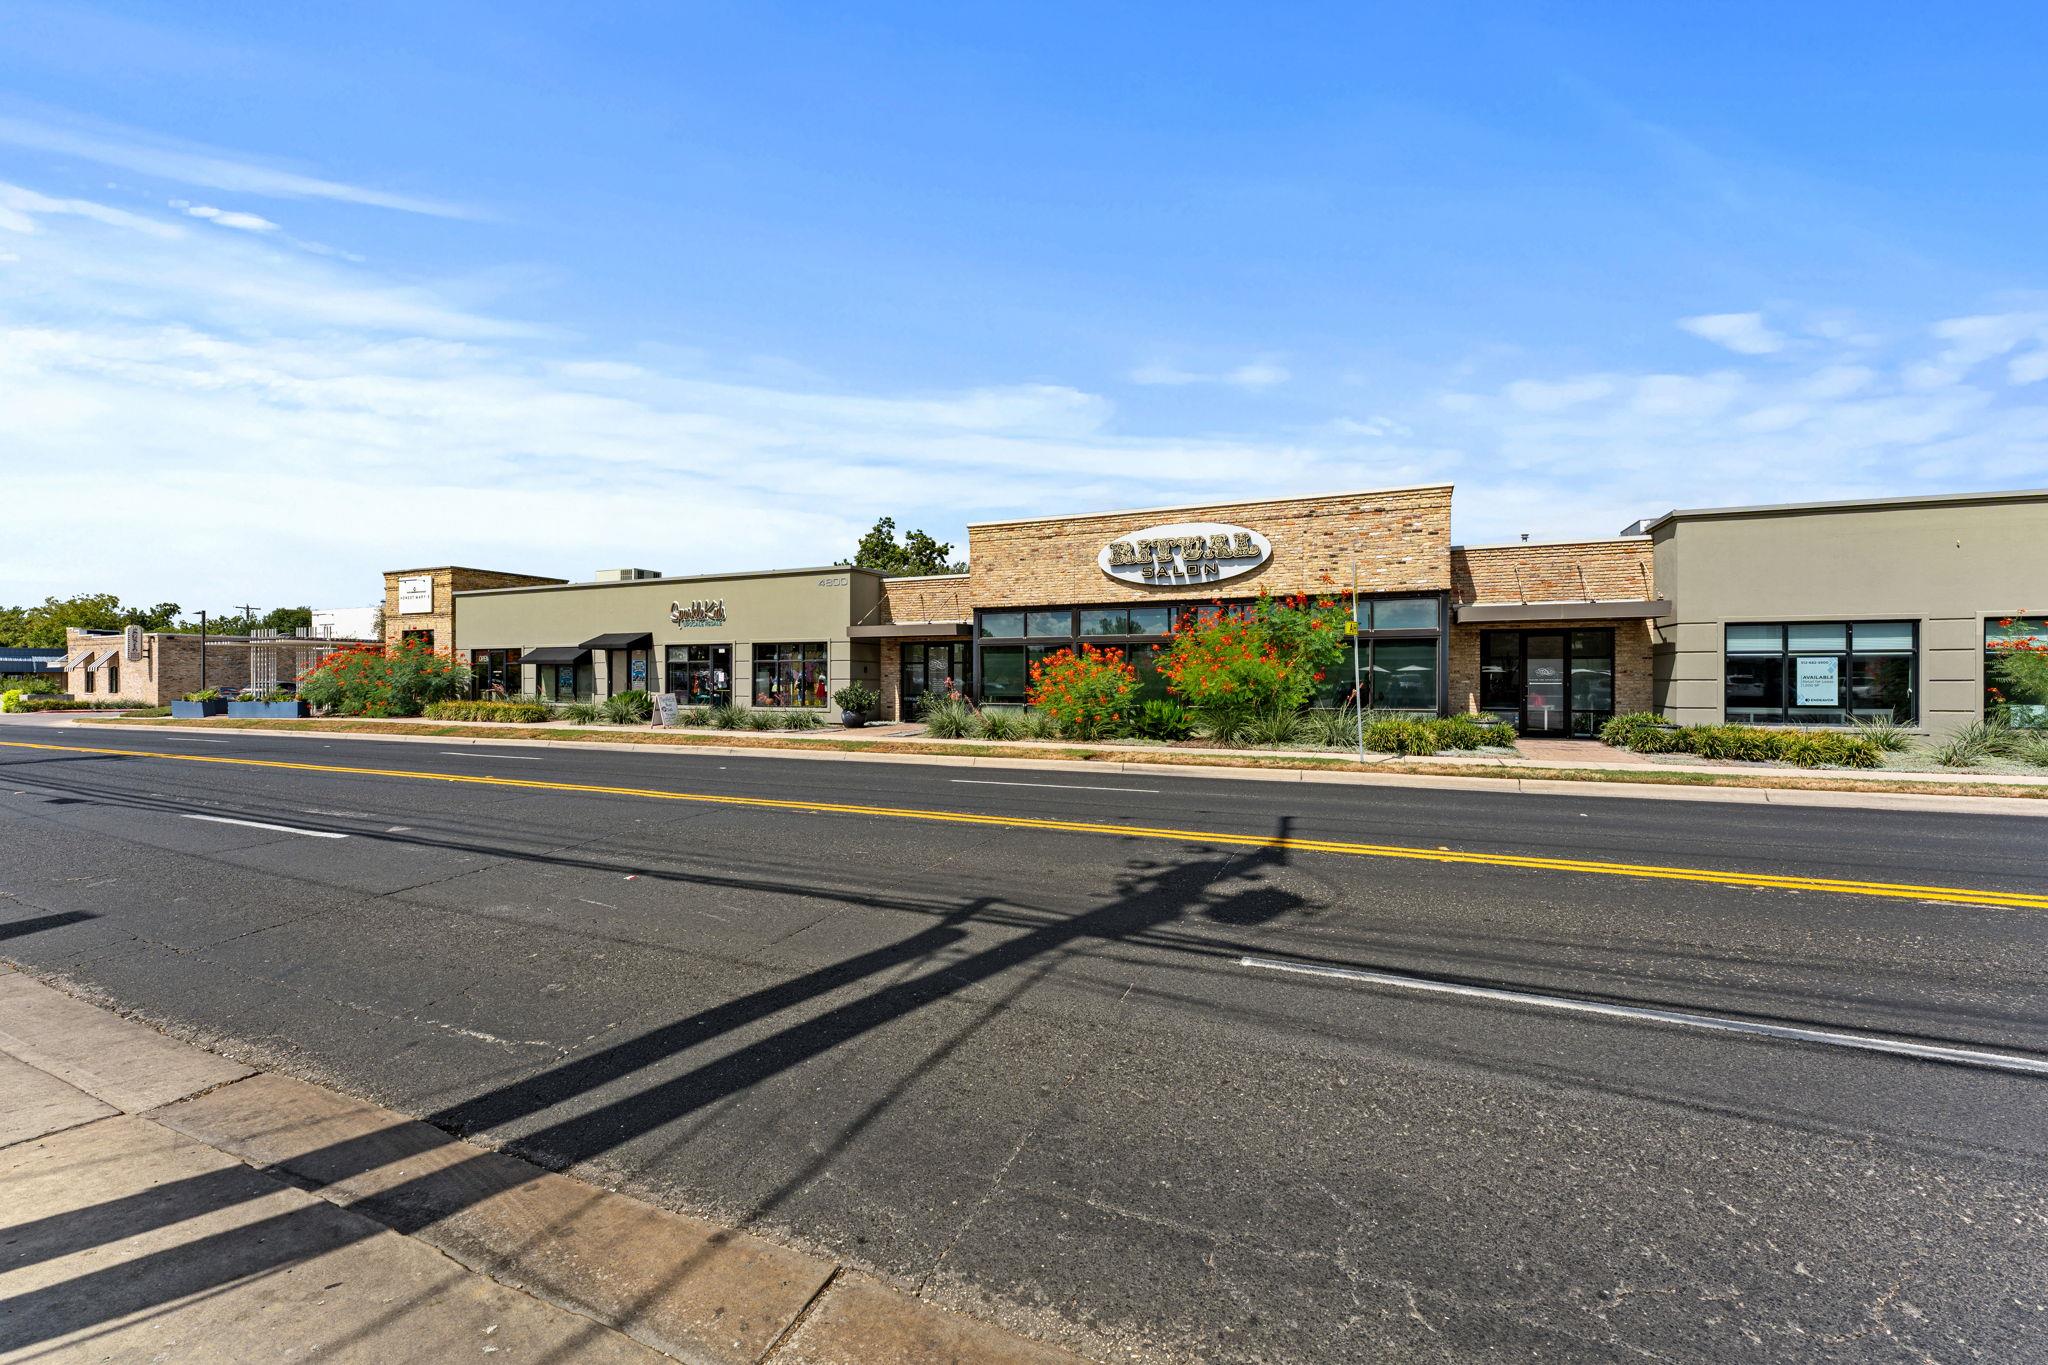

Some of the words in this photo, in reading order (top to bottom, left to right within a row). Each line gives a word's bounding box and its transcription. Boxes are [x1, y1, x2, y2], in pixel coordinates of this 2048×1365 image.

[1108, 532, 1261, 566] RITUAL
[1141, 563, 1219, 578] SALON
[817, 578, 849, 587] 4800
